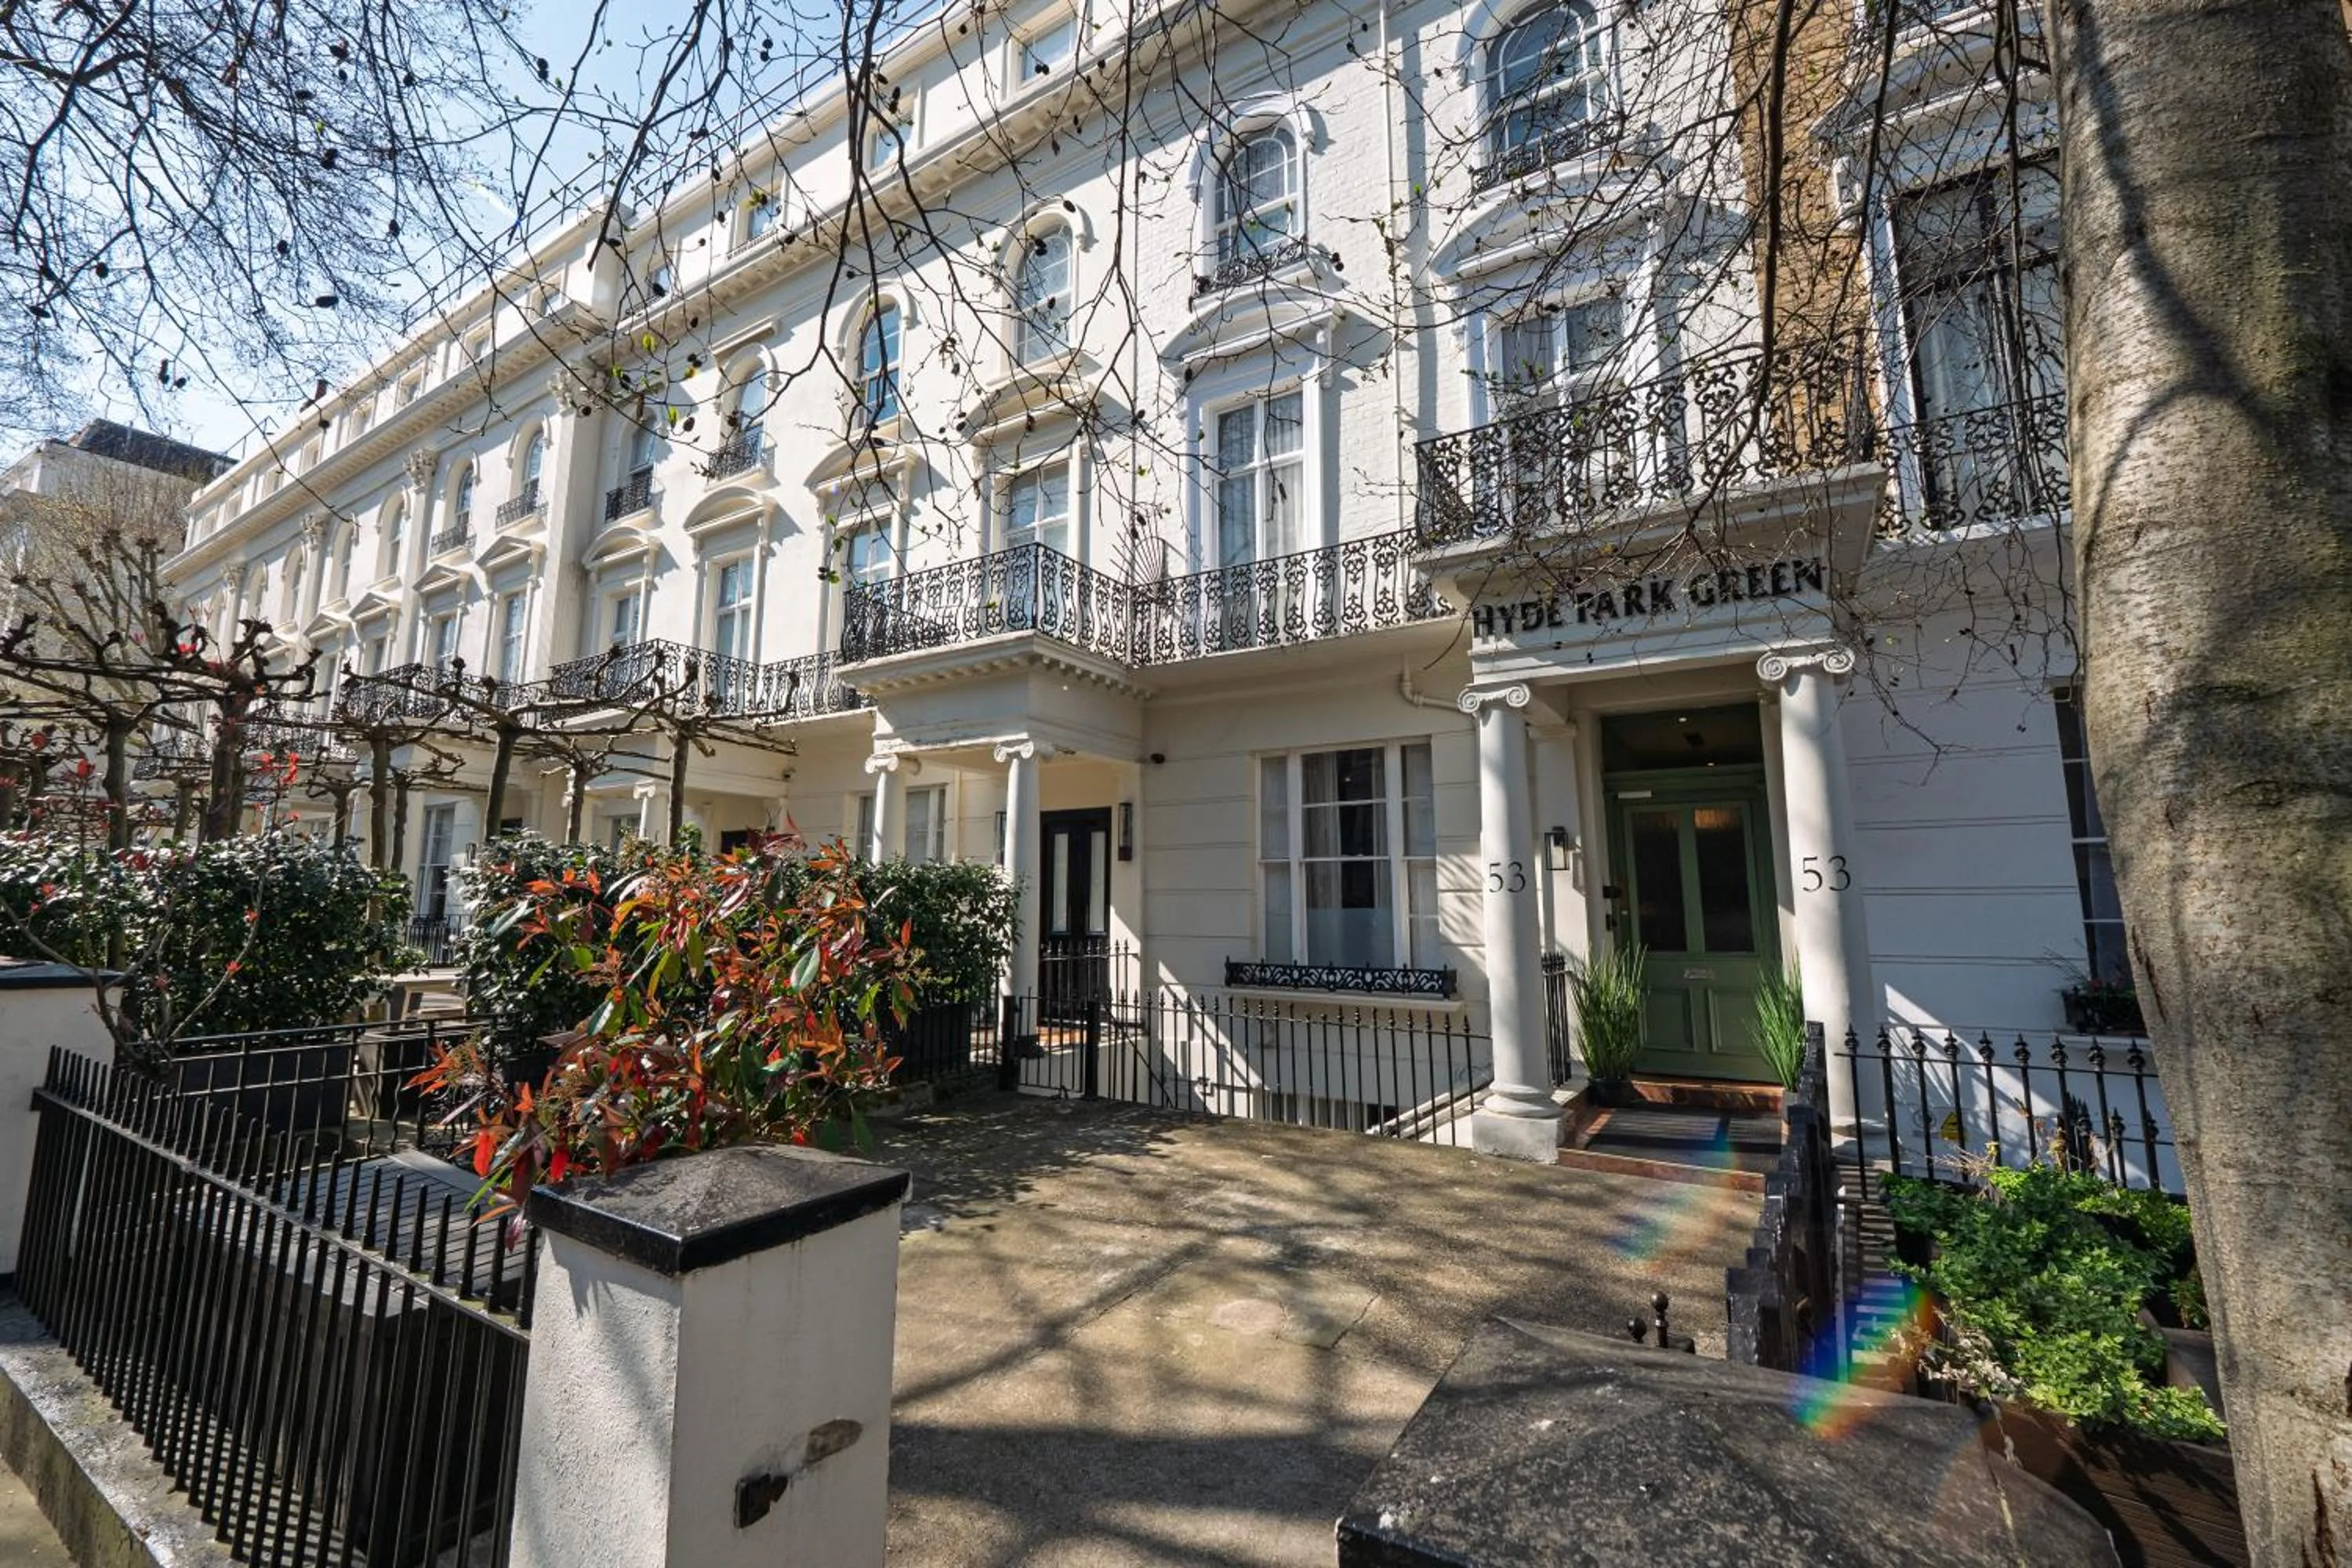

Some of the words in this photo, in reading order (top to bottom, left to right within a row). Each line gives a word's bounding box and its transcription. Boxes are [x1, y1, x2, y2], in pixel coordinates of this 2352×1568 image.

[1473, 598, 1563, 638] HYDE
[1577, 579, 1675, 622] PARK
[1689, 558, 1822, 605] GREEN
[1490, 862, 1525, 893] 53
[1803, 855, 1851, 891] 53
